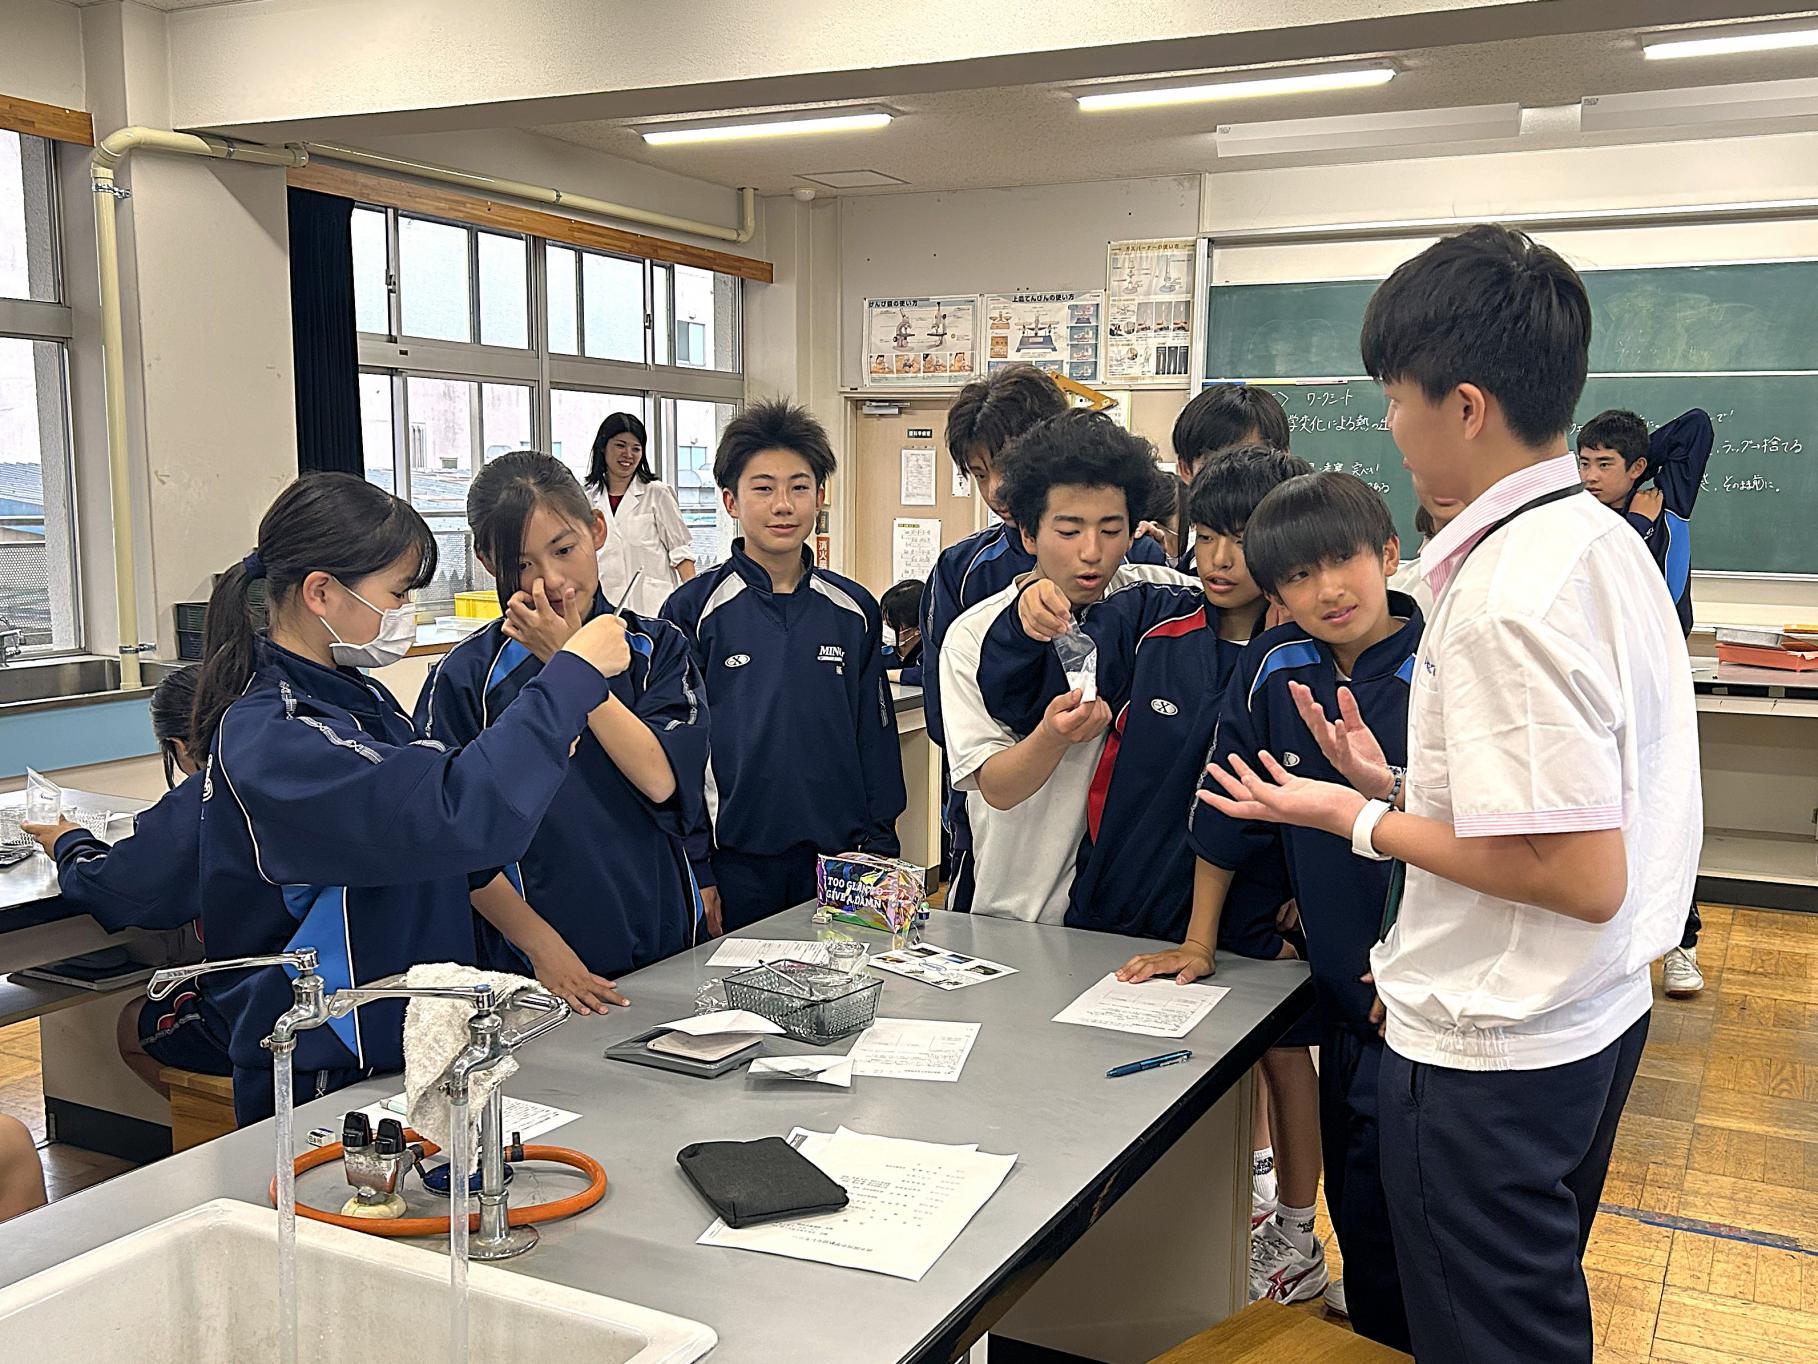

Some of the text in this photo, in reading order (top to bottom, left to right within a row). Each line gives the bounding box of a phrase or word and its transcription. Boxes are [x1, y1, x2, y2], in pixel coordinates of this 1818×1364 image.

[1012, 293, 1075, 302] 上皿てんびんの使い方
[1307, 389, 1353, 406] ワークシート
[827, 876, 845, 889] TOO
[826, 888, 846, 902] GIVE
[854, 895, 882, 908] DAMN
